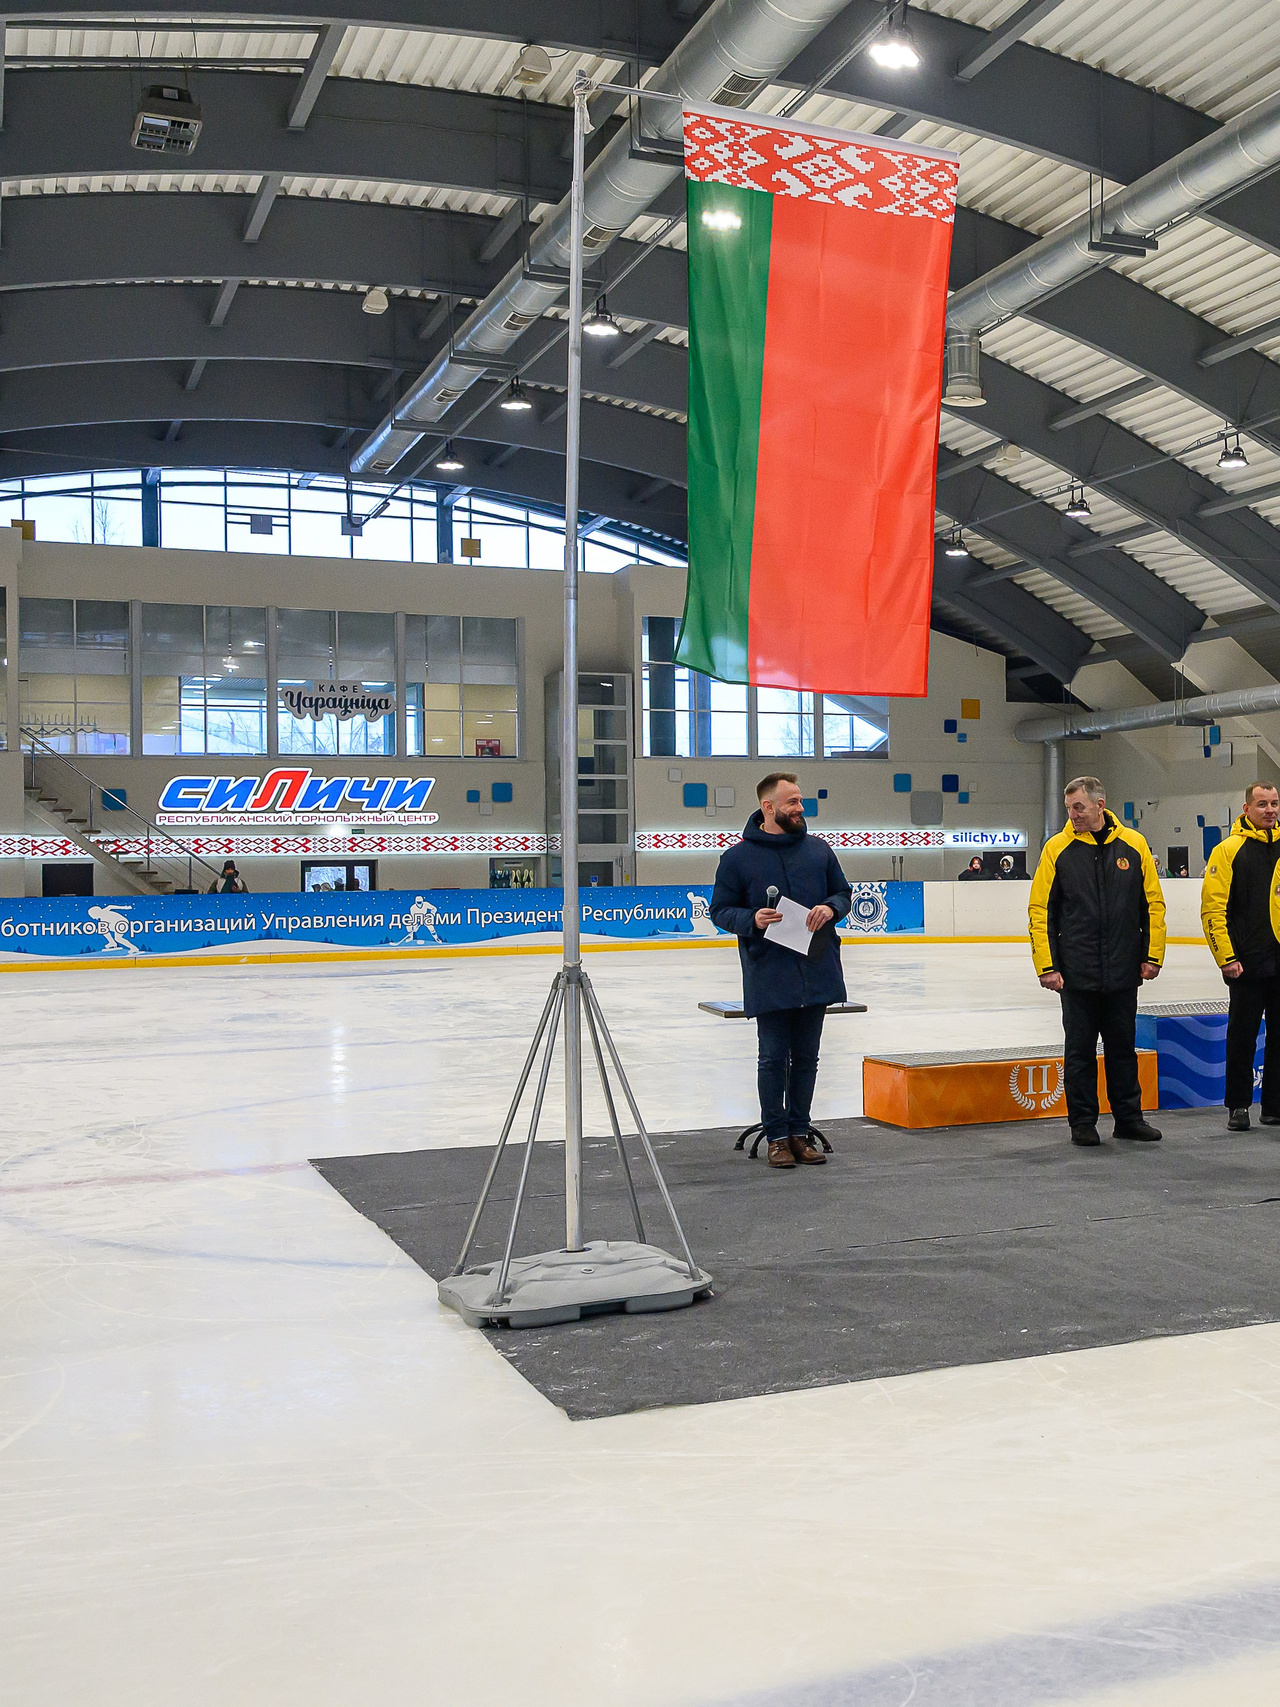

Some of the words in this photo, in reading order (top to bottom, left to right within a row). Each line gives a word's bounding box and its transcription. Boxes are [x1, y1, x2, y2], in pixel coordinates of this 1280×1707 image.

[318, 684, 359, 693] КАФЕ
[285, 691, 392, 718] Чараўніца
[158, 813, 293, 823] РЕСПУБЛИКАНСКИЙ
[295, 813, 395, 823] ГОРНОЛЫЖНЫЙ
[397, 814, 437, 825] ЦЕНТР
[952, 832, 1020, 844] silichy.by
[1, 917, 109, 937] ботников
[115, 914, 256, 938] организаций
[261, 912, 384, 934] Управления
[388, 911, 461, 930] делами
[467, 908, 564, 928] Президент
[582, 904, 687, 926] Республики
[1207, 919, 1219, 953] BELARUS
[1025, 1064, 1051, 1095] II
